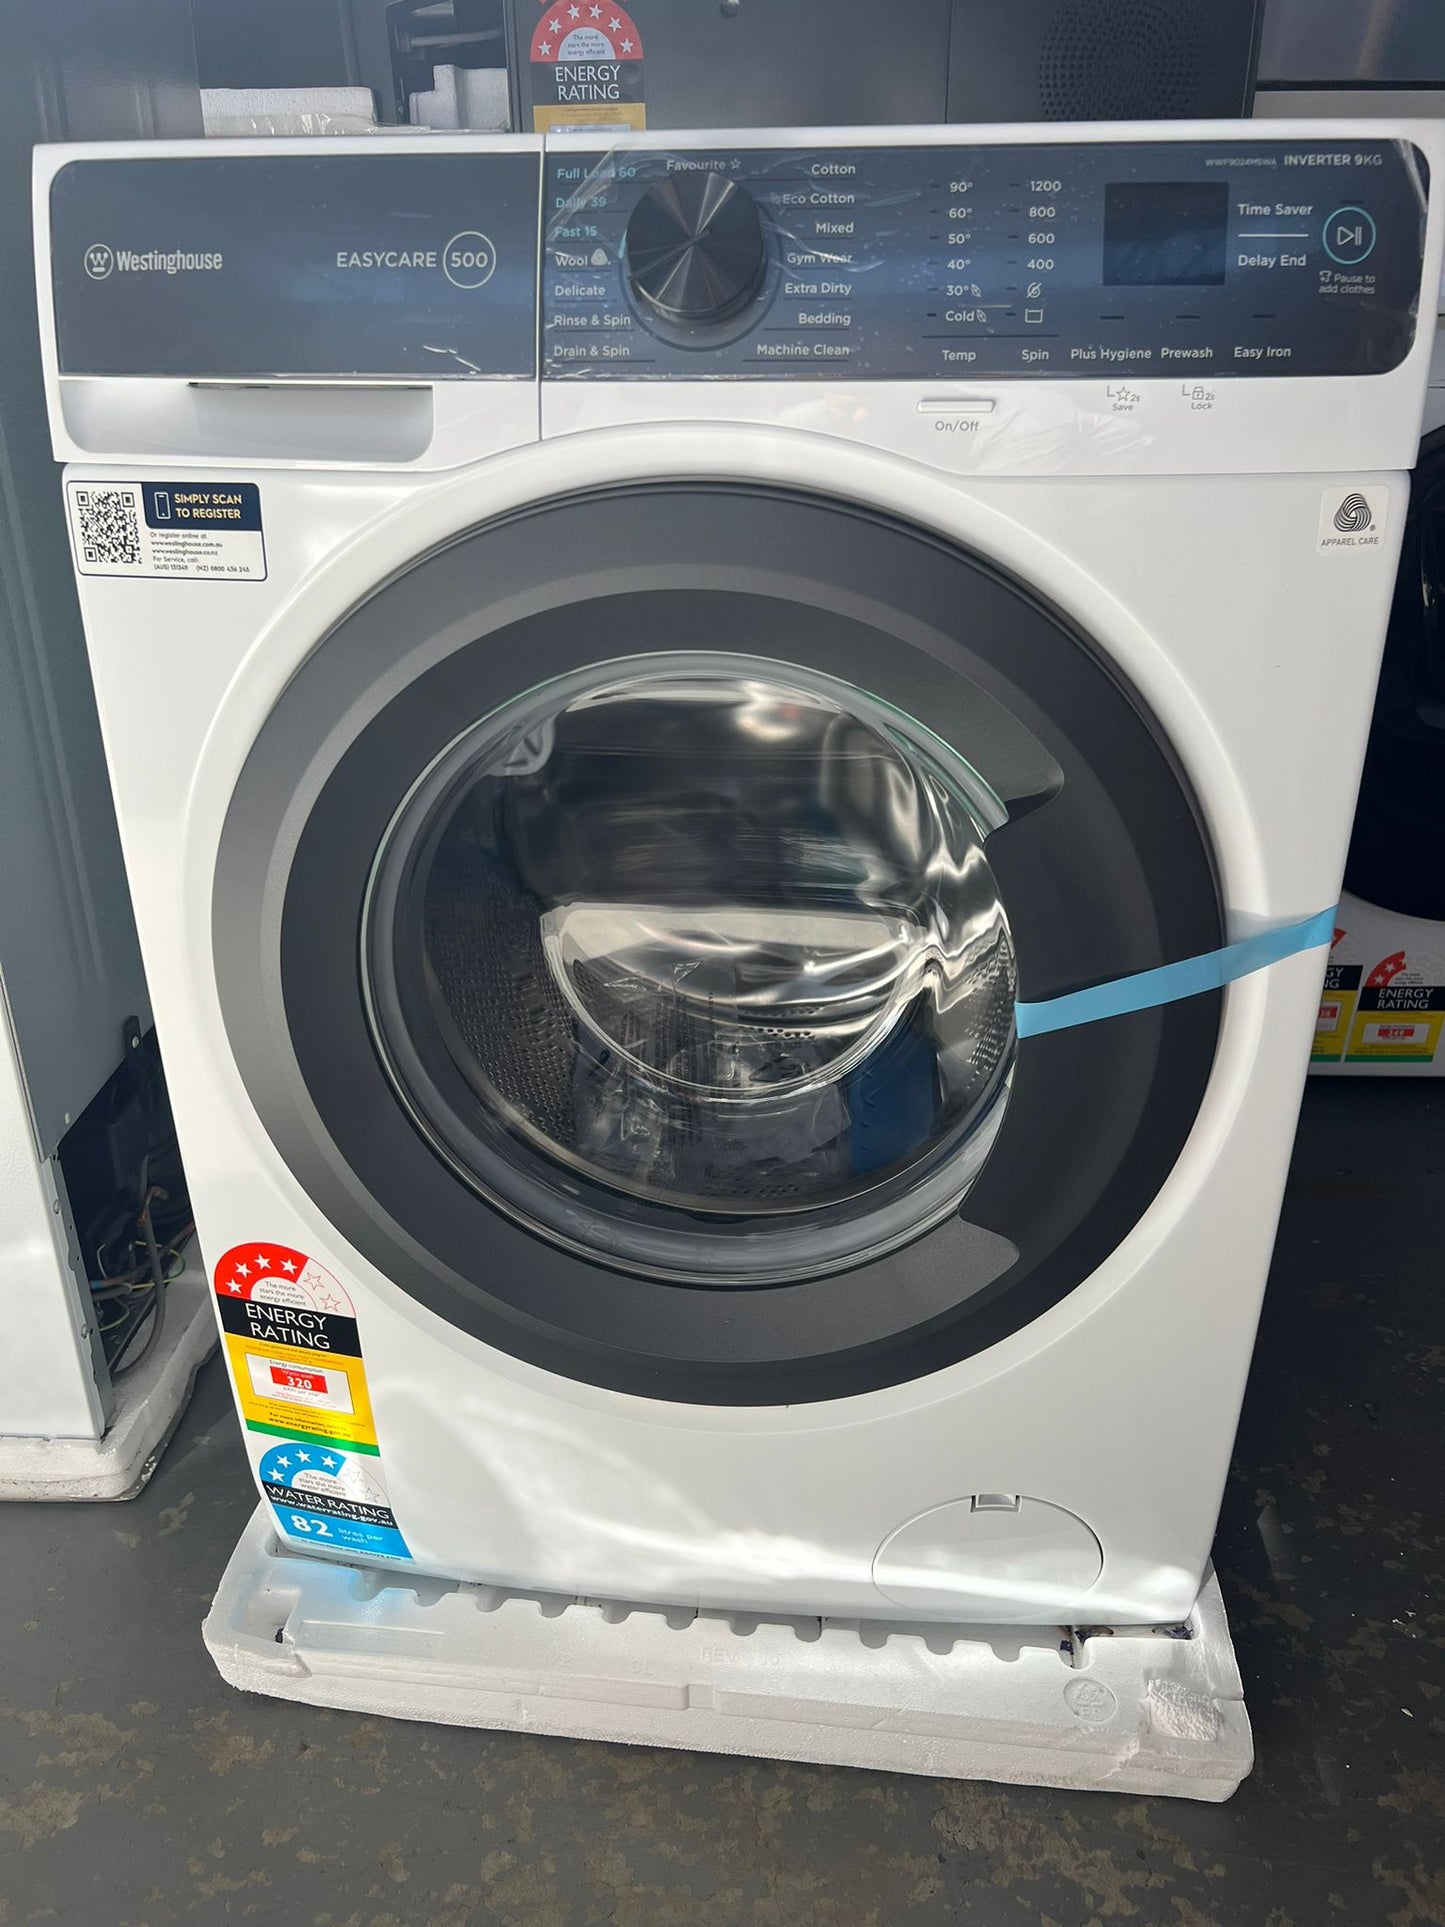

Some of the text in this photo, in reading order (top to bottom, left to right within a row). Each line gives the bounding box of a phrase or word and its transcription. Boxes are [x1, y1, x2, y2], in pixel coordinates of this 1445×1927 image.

[555, 65, 620, 82] ENERGY
[558, 84, 620, 101] RATING
[666, 160, 726, 171] Favourite
[1284, 154, 1383, 166] INVERTER 9KG
[557, 168, 580, 179] Full
[619, 168, 636, 178] 60
[811, 164, 856, 175] Cotton
[1030, 181, 1062, 192] 1200
[590, 197, 606, 208] 39
[782, 194, 855, 204] Eco Cotton
[1028, 207, 1056, 218] 800
[1238, 204, 1313, 216] Time Saver
[554, 226, 597, 238] Fast 15
[816, 222, 854, 234] Mixed
[1028, 234, 1055, 244] 600
[116, 250, 222, 274] Westinghouse
[336, 251, 436, 268] EASYCARE
[450, 251, 488, 268] 500
[555, 255, 588, 266] Wool
[787, 254, 816, 266] Gym
[1027, 259, 1054, 270] 400
[1238, 255, 1306, 269] Delay End
[1334, 274, 1376, 284] Pause to
[554, 285, 606, 296] Delicate
[784, 282, 852, 296] Extra Dirty
[1319, 284, 1376, 294] add clothes
[554, 314, 631, 327] Rinse & Spin
[798, 313, 851, 326] Bedding
[946, 311, 974, 322] Cold
[554, 344, 630, 357] Drain & Spin
[757, 344, 850, 356] Machine Clean
[942, 350, 976, 362] Temp
[1071, 348, 1152, 361] Plus Hygiene
[1161, 347, 1213, 358] Prewash
[1234, 346, 1292, 360] Easy Iron
[1022, 350, 1049, 363] Spin
[1112, 403, 1134, 412] Save
[1191, 402, 1212, 410] Lock
[934, 421, 979, 433] On/Off
[174, 494, 242, 504] SIMPLY SCAN
[176, 508, 241, 520] TO REGISTER
[159, 532, 180, 540] register
[1321, 536, 1379, 546] APPAREL CARE
[1378, 988, 1434, 998] ENERGY
[1377, 999, 1429, 1010] RATING
[245, 1302, 327, 1330] ENERGY
[250, 1322, 330, 1350] RATING
[286, 1376, 312, 1390] 320
[266, 1484, 390, 1519] WATER RATING
[291, 1515, 334, 1538] 82
